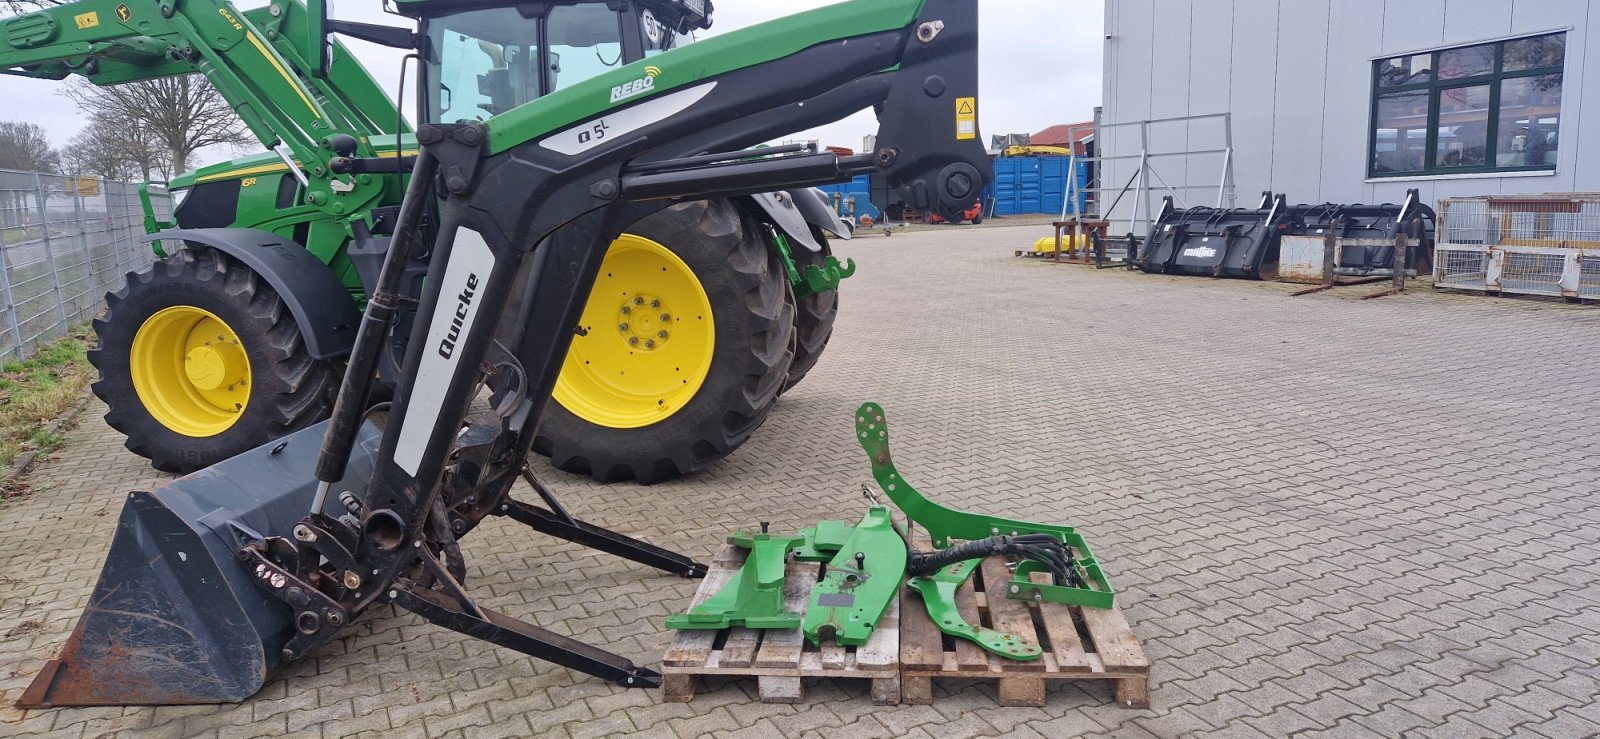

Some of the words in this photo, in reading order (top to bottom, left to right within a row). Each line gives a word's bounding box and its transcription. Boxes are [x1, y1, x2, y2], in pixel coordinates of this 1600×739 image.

[645, 15, 657, 37] 50
[611, 76, 655, 102] REBO
[242, 177, 256, 187] 6R
[438, 273, 479, 360] Quicke
